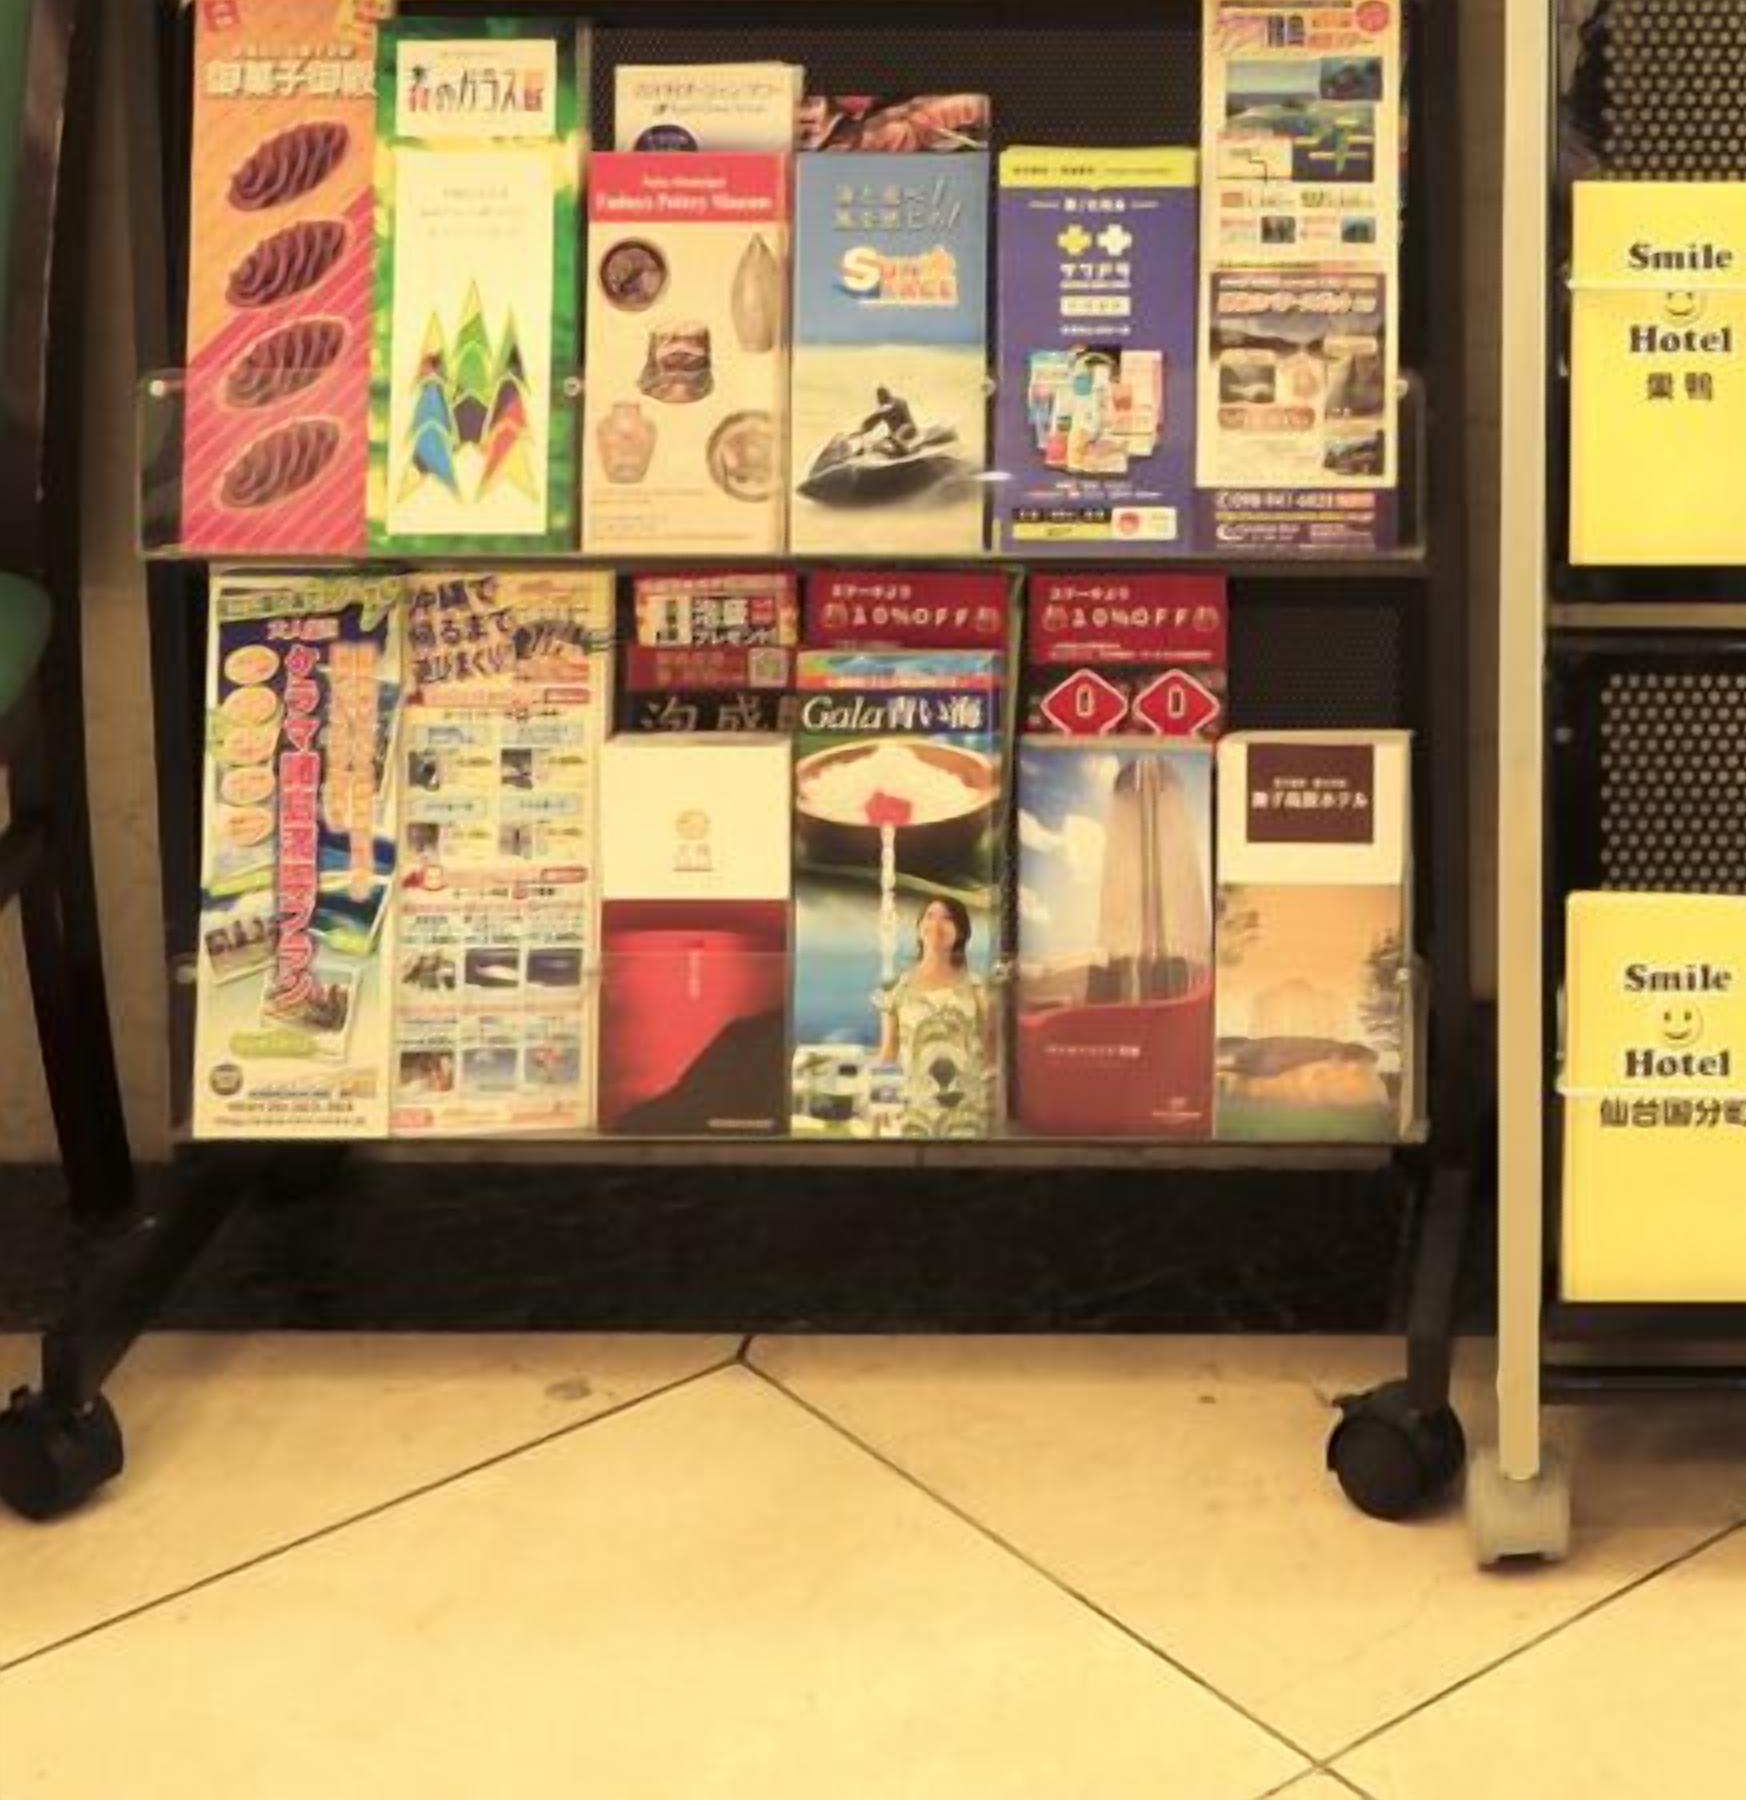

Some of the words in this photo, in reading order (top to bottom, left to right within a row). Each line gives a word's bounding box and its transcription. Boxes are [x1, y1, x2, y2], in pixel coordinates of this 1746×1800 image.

[1629, 243, 1734, 272] Smile
[1630, 325, 1733, 355] Hotel
[1625, 964, 1733, 993] Smile
[1626, 1049, 1732, 1080] Hotel
